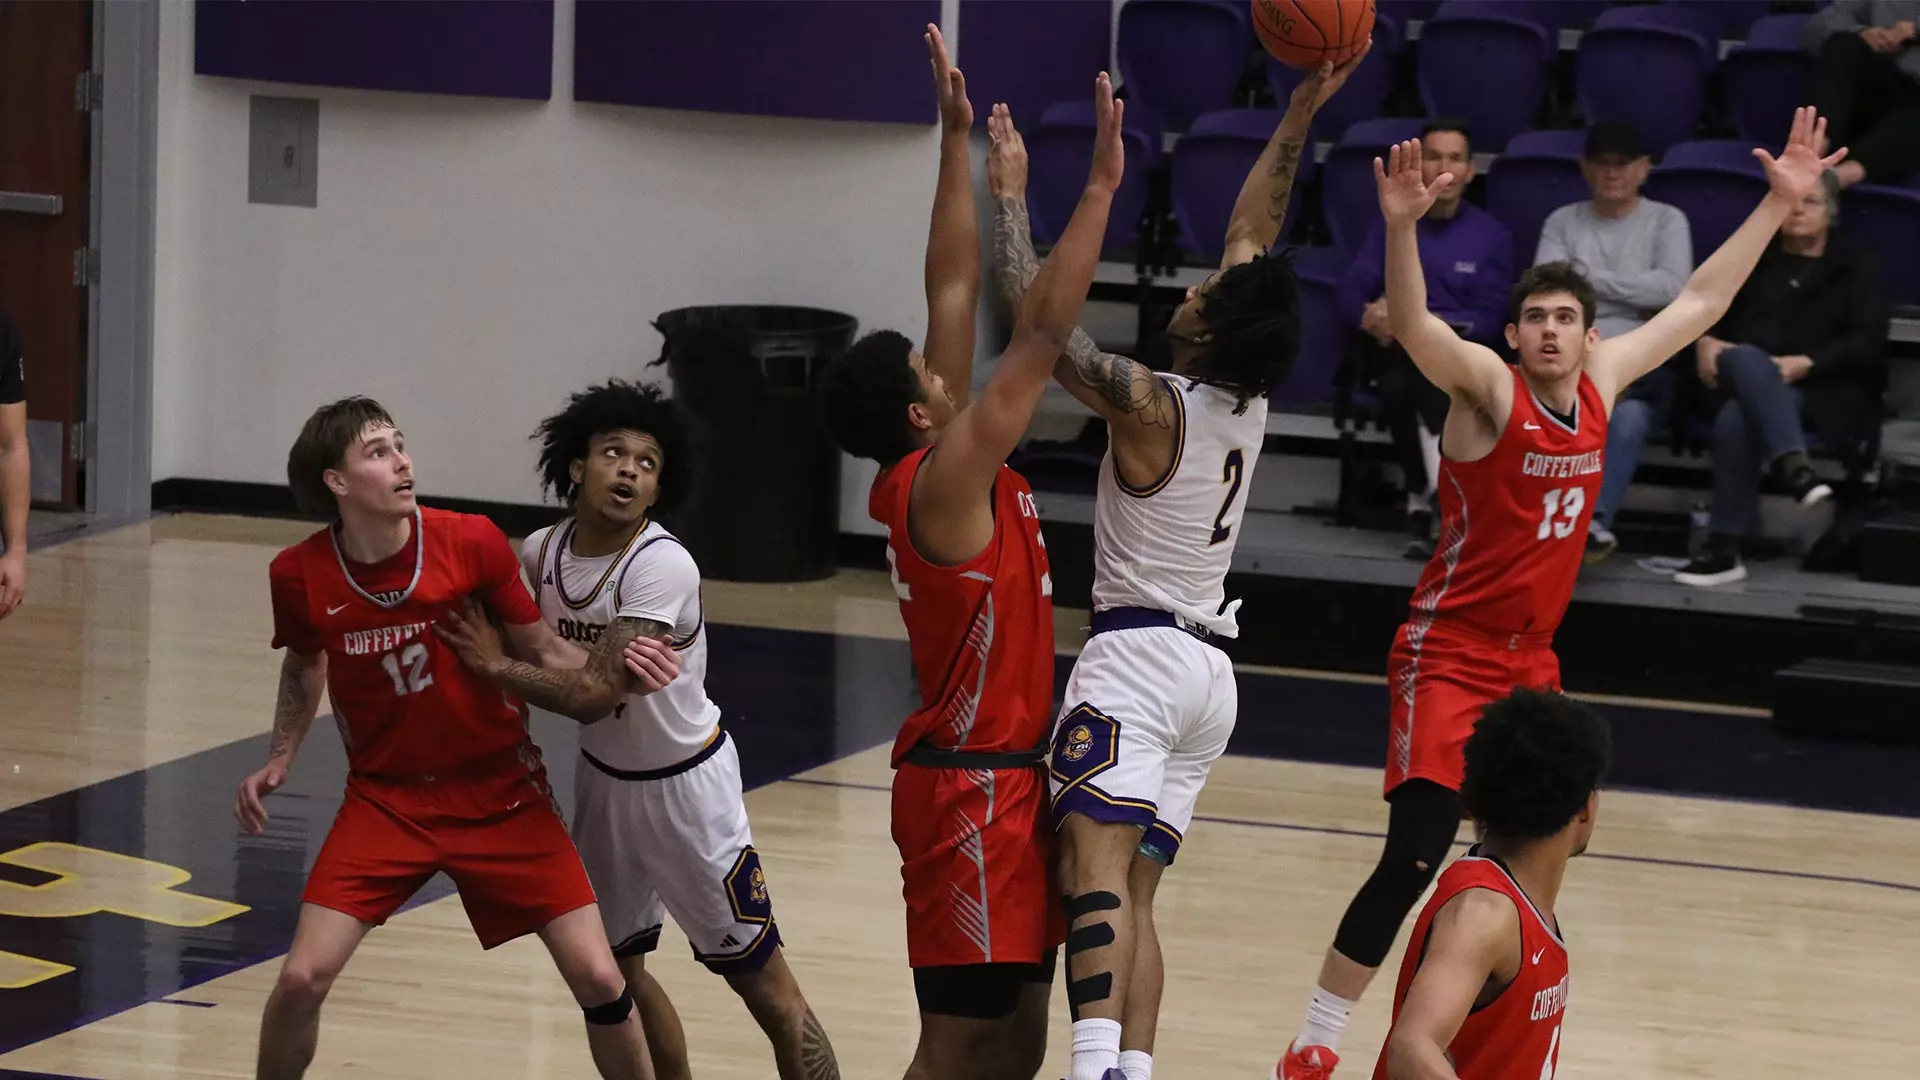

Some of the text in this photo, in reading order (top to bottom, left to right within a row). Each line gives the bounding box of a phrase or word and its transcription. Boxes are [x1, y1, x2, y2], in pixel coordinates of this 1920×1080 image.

[1209, 448, 1244, 547] 2
[1536, 485, 1586, 541] 13
[381, 642, 434, 697] 12
